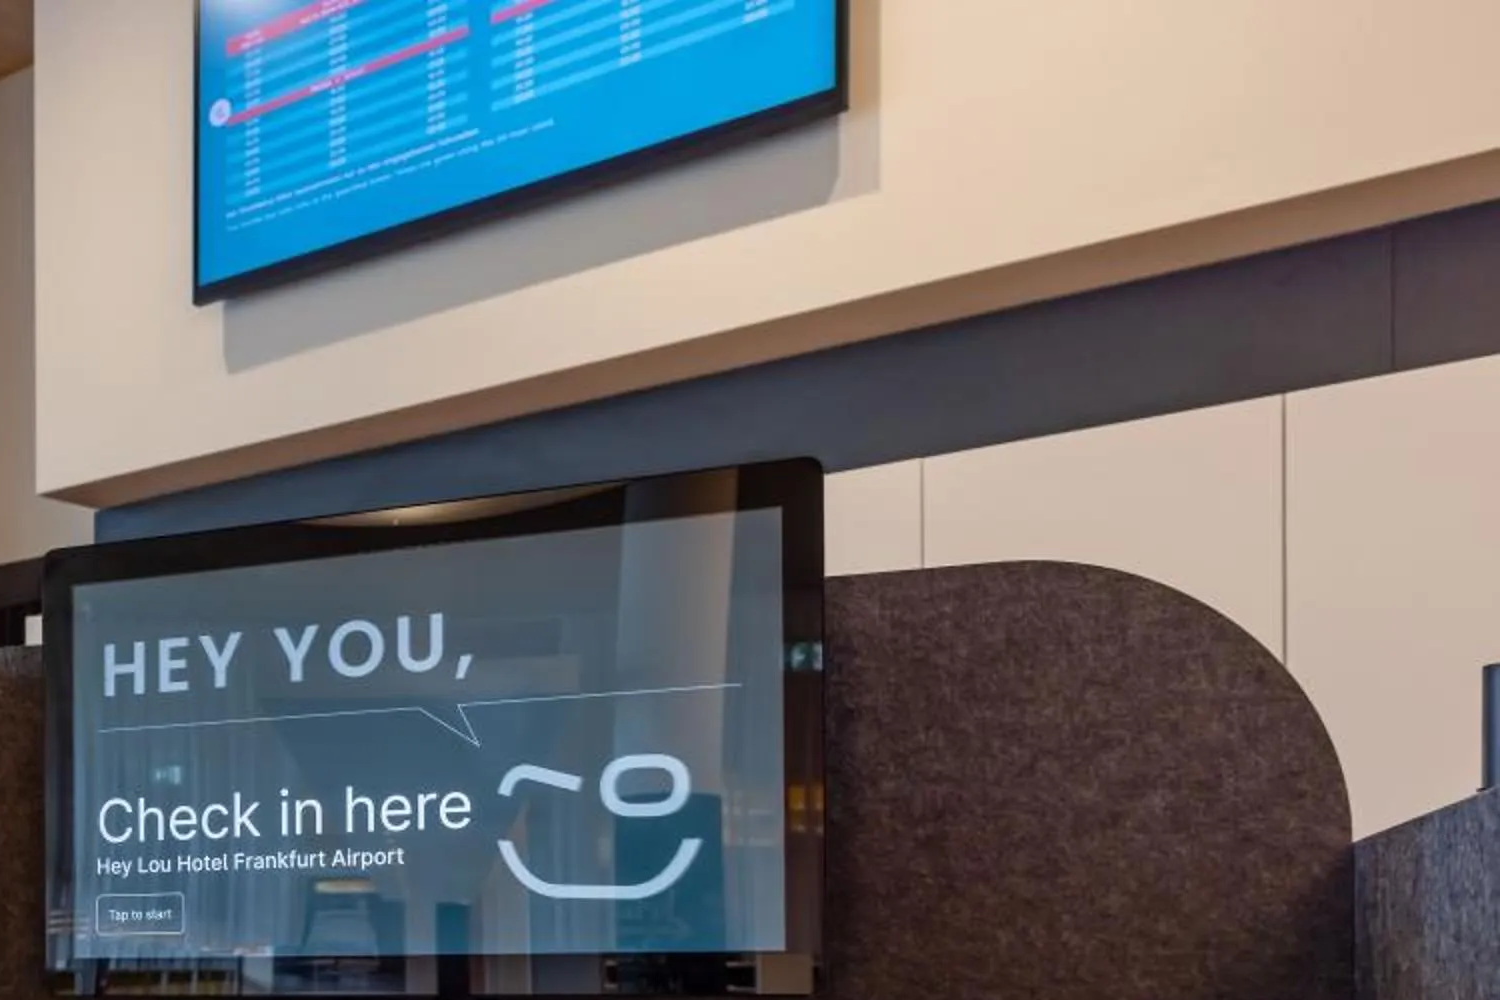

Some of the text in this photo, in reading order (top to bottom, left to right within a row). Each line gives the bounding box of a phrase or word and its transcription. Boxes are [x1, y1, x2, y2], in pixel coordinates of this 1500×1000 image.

[103, 612, 474, 697] HEY YOU,
[99, 785, 472, 844] Check in here
[97, 847, 405, 878] Hey Lou Hotel Frankfurt Airport
[108, 908, 172, 923] Tap to start
